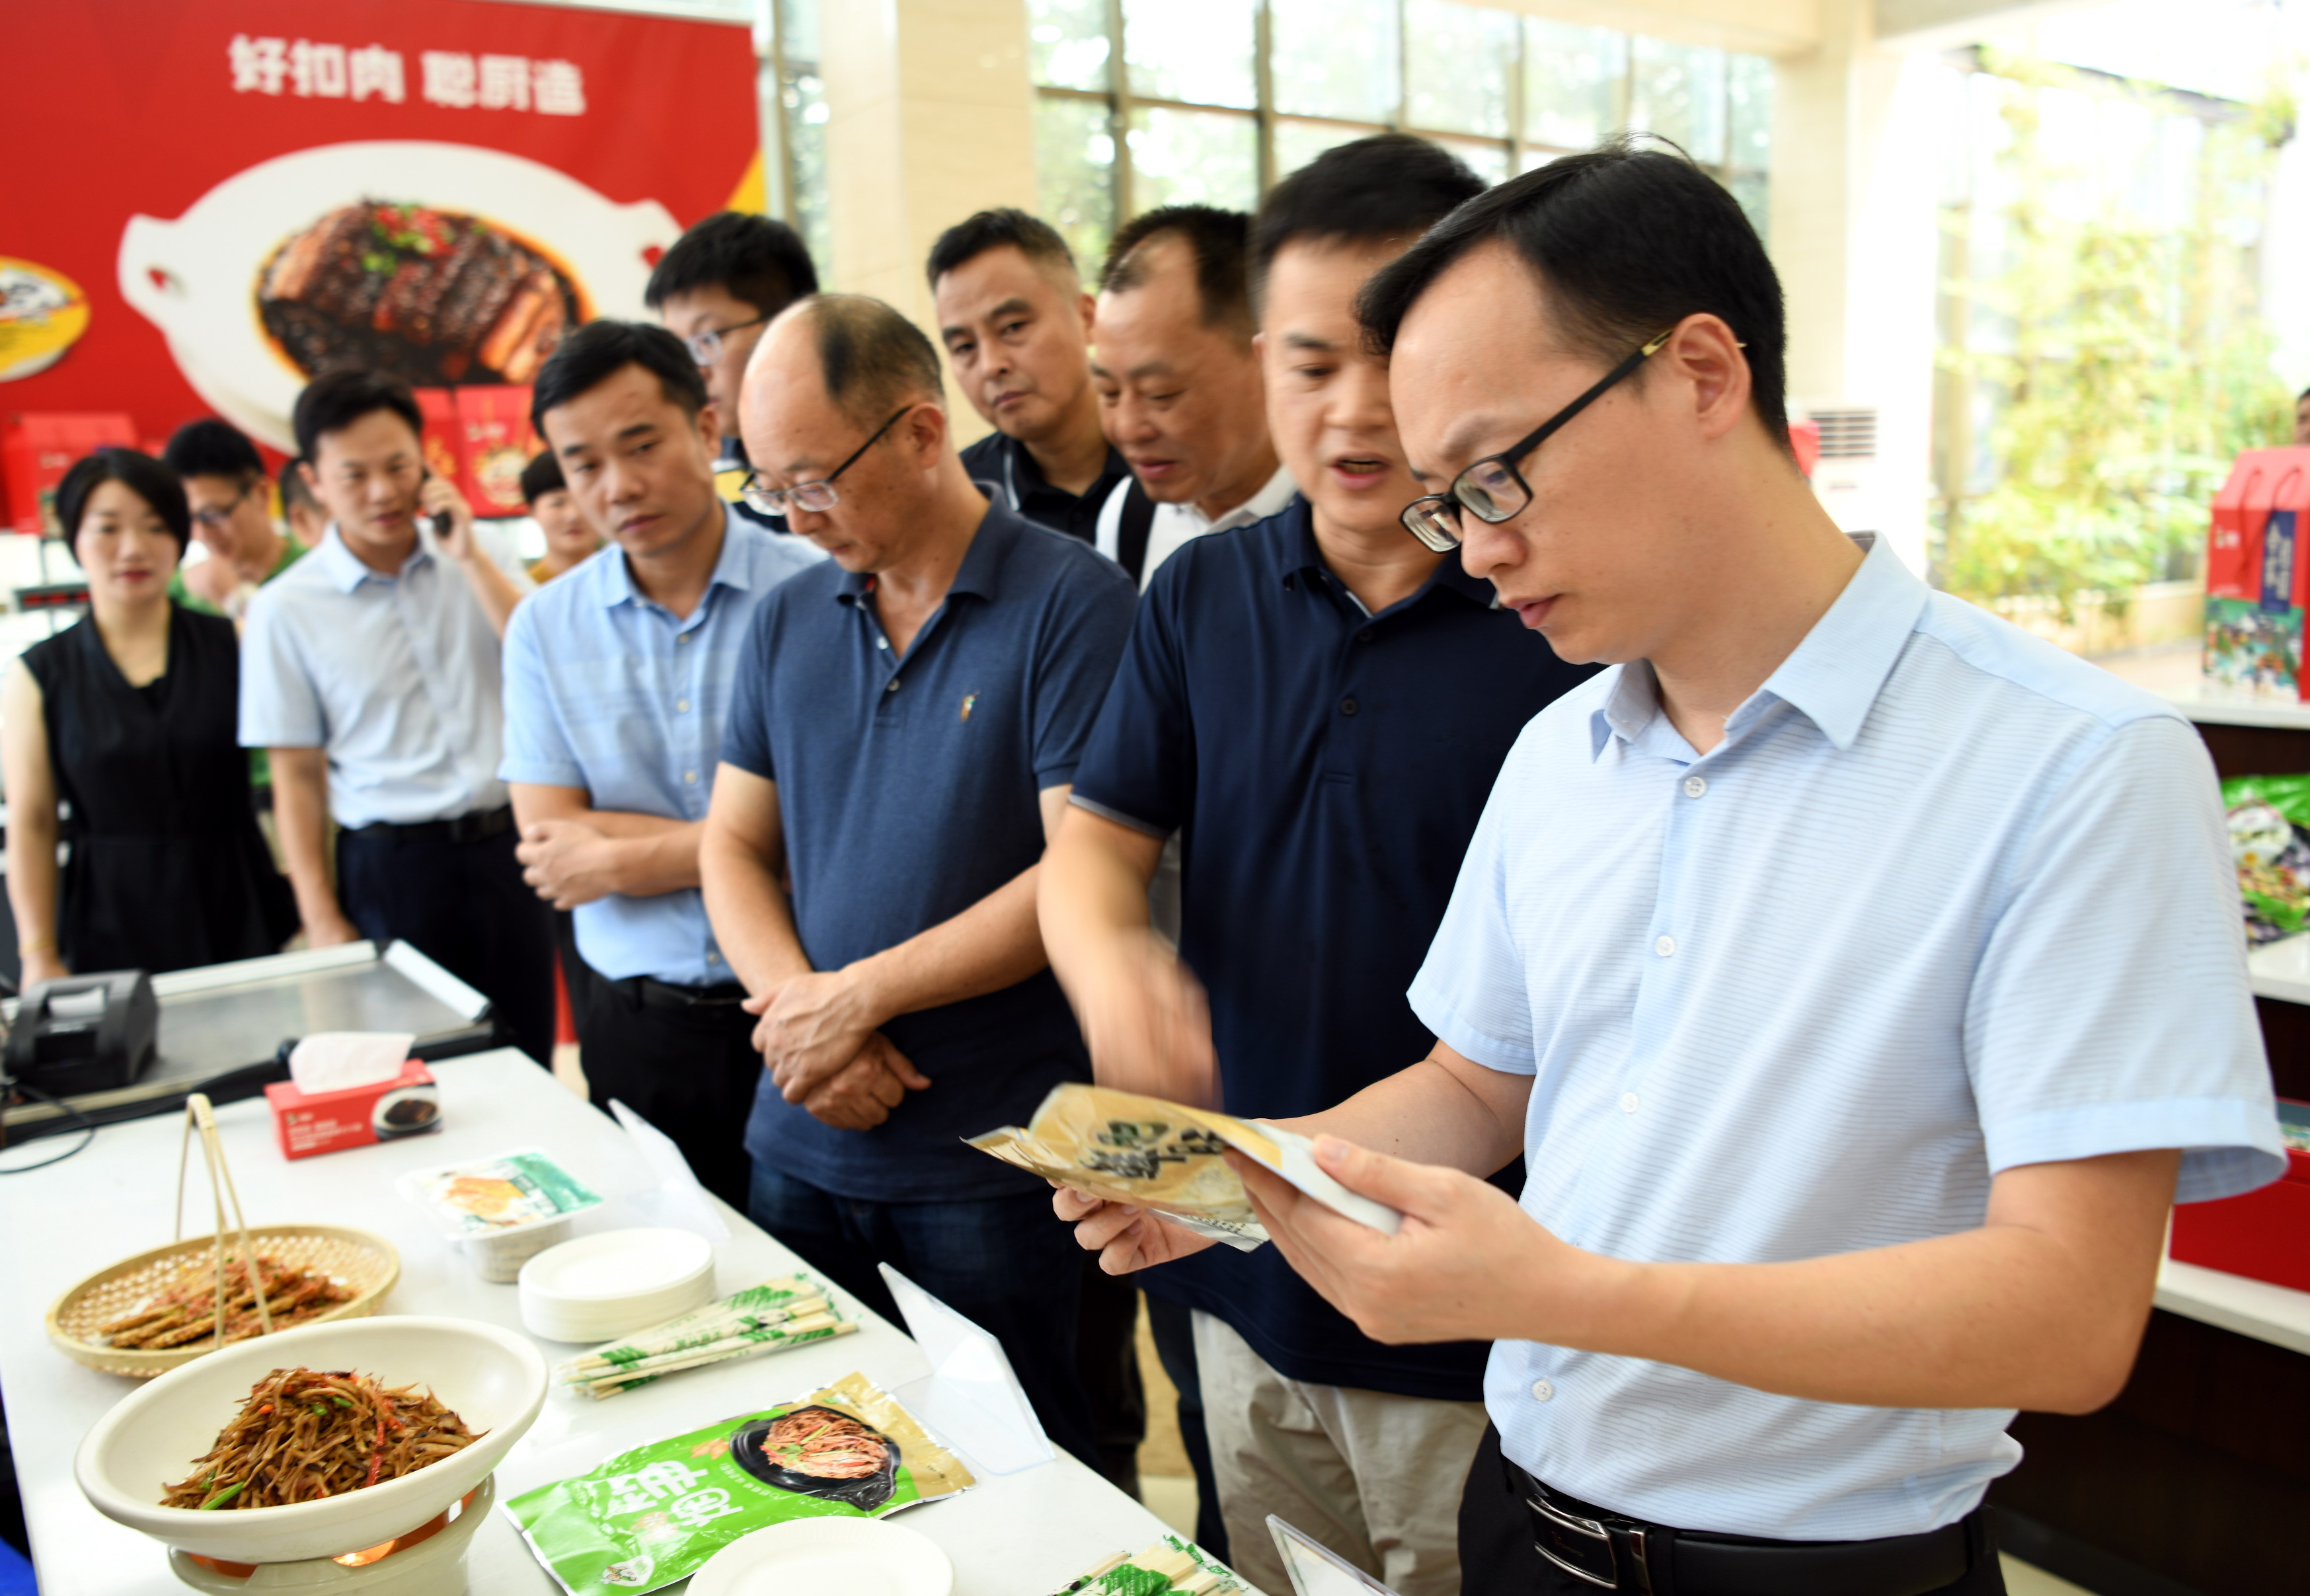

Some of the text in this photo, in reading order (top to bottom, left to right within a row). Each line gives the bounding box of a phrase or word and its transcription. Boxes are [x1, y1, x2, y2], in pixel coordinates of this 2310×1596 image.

[227, 32, 587, 117] 好扣肉 聪厨造
